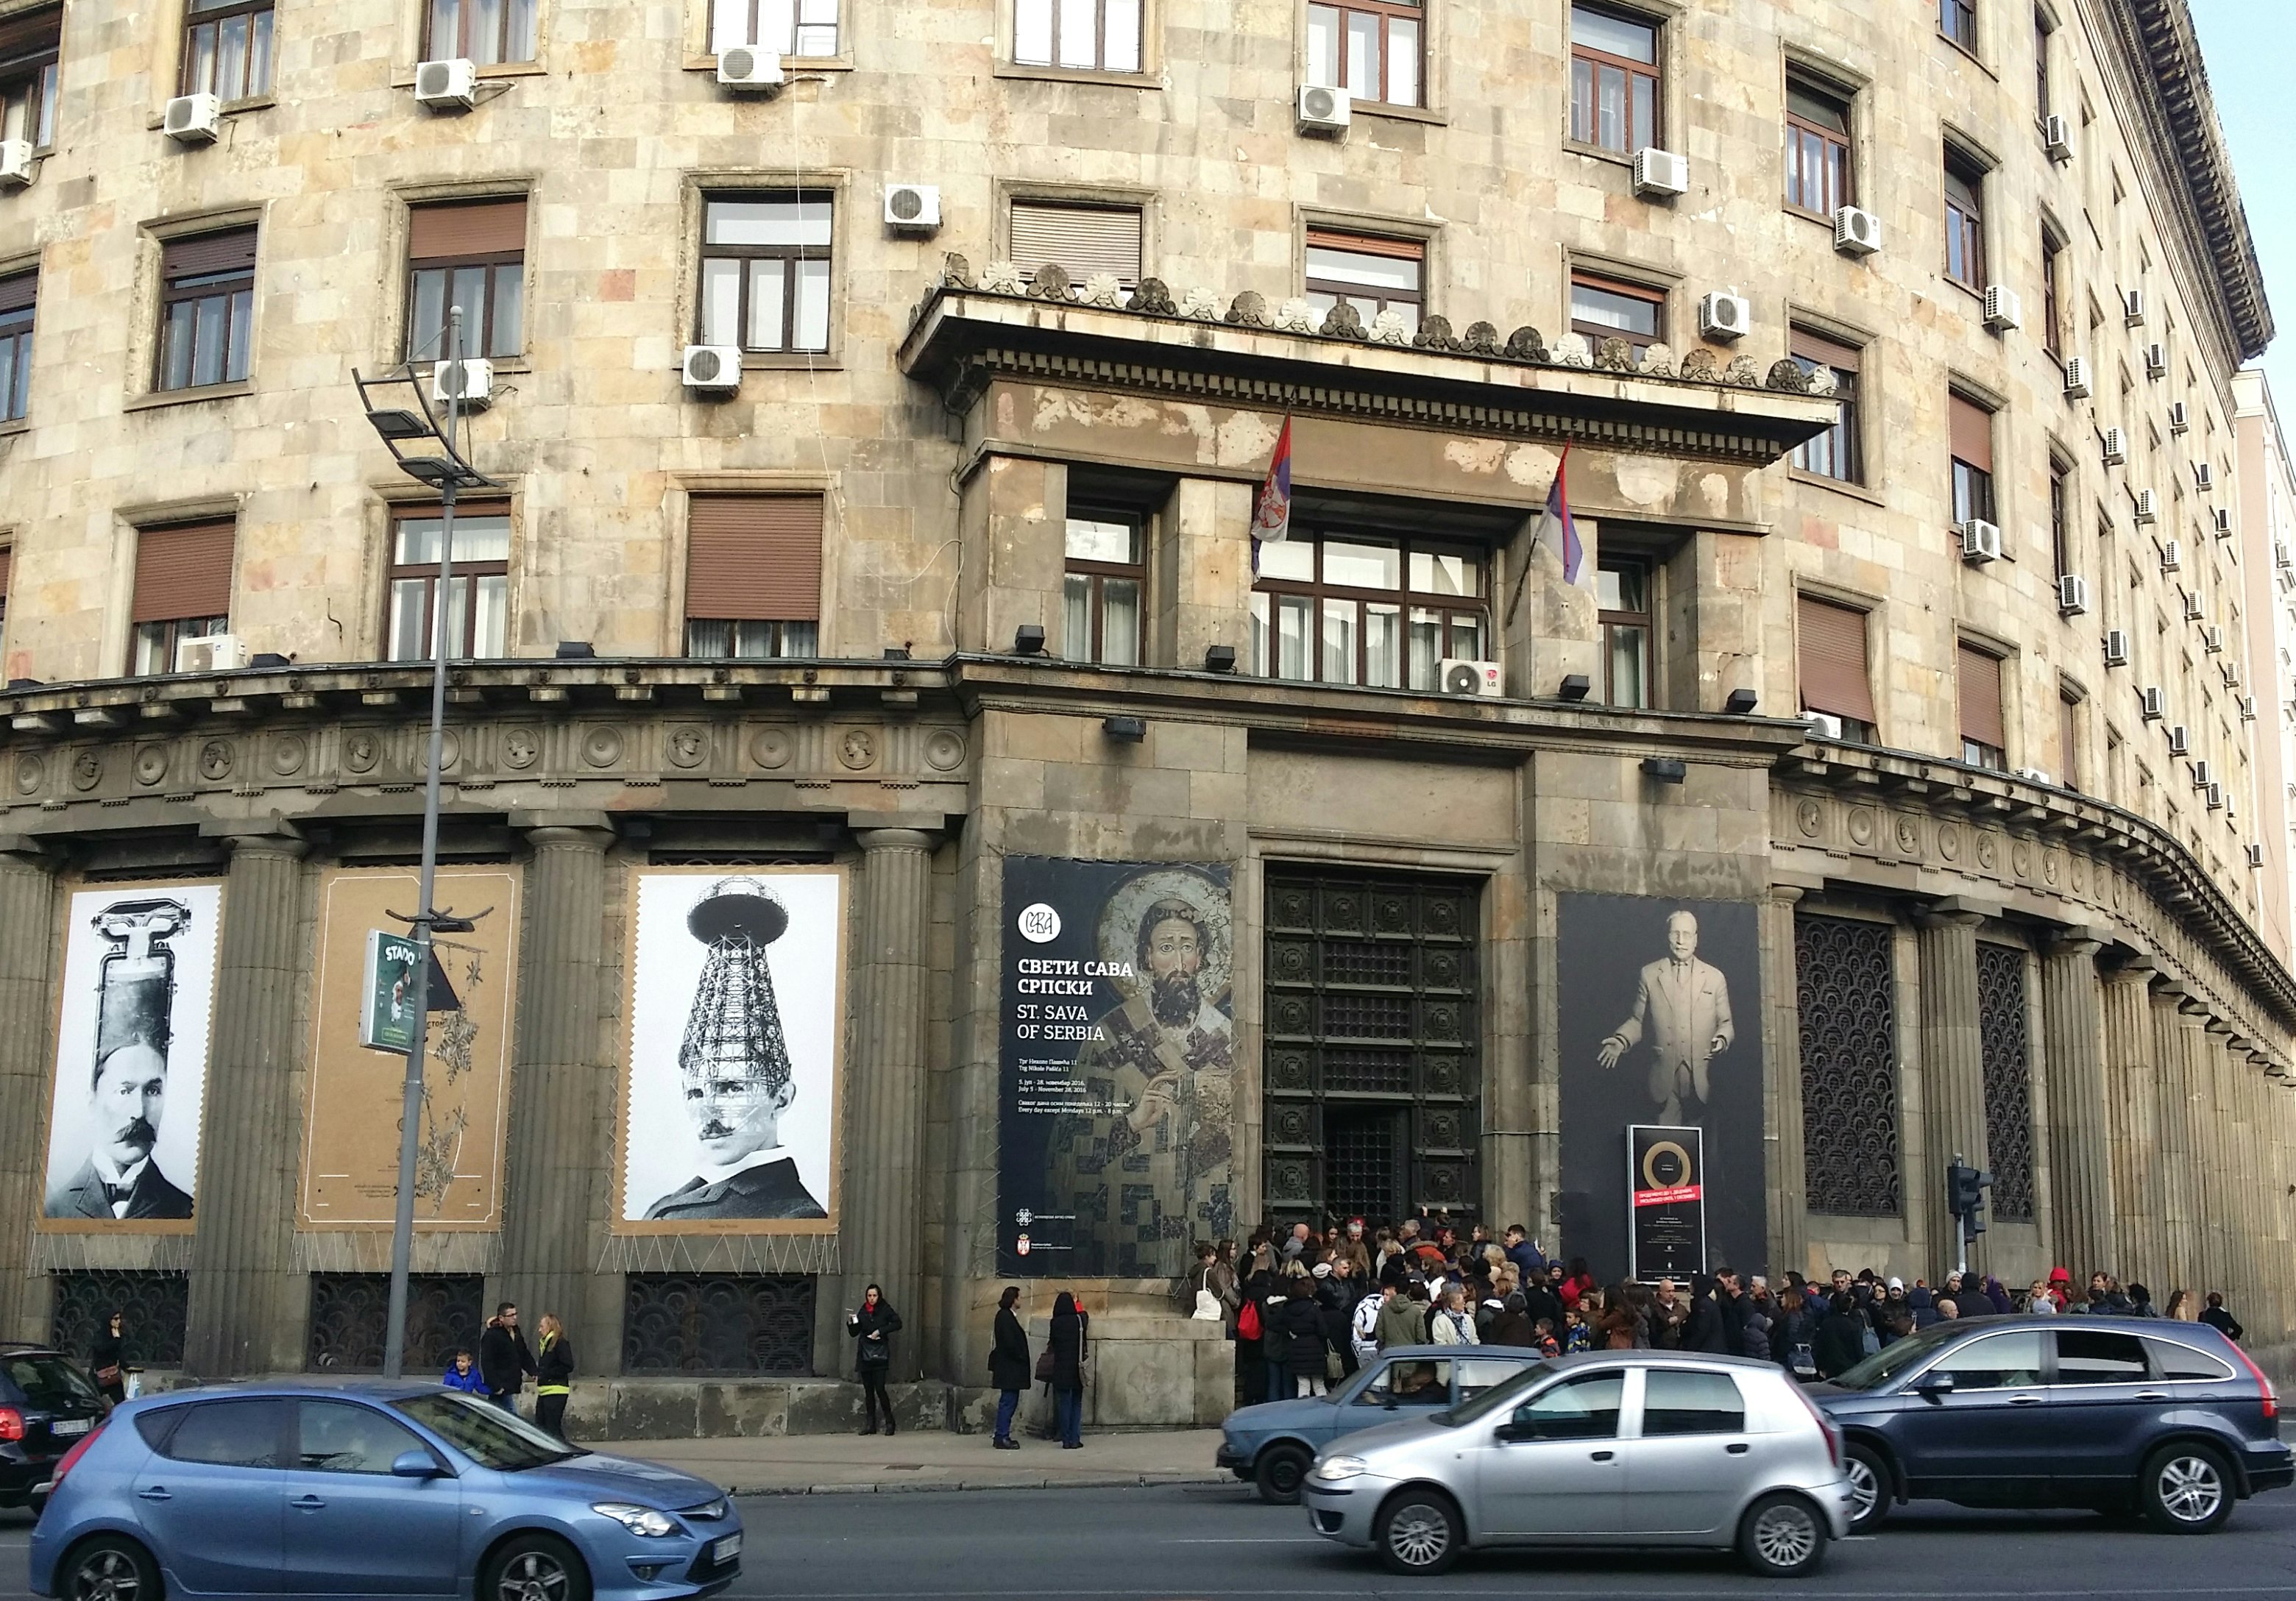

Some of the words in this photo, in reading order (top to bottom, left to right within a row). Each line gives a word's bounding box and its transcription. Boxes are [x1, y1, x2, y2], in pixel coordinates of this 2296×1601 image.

[385, 945, 415, 966] STADO
[1018, 958, 1079, 975] СВЕТИ
[1084, 961, 1133, 977] САВА
[1018, 979, 1093, 995] СРПСКИ
[1017, 1004, 1041, 1020] ST.
[1044, 1005, 1088, 1020] SAVA
[1017, 1024, 1040, 1039] OF
[1044, 1025, 1105, 1041] SERBIA
